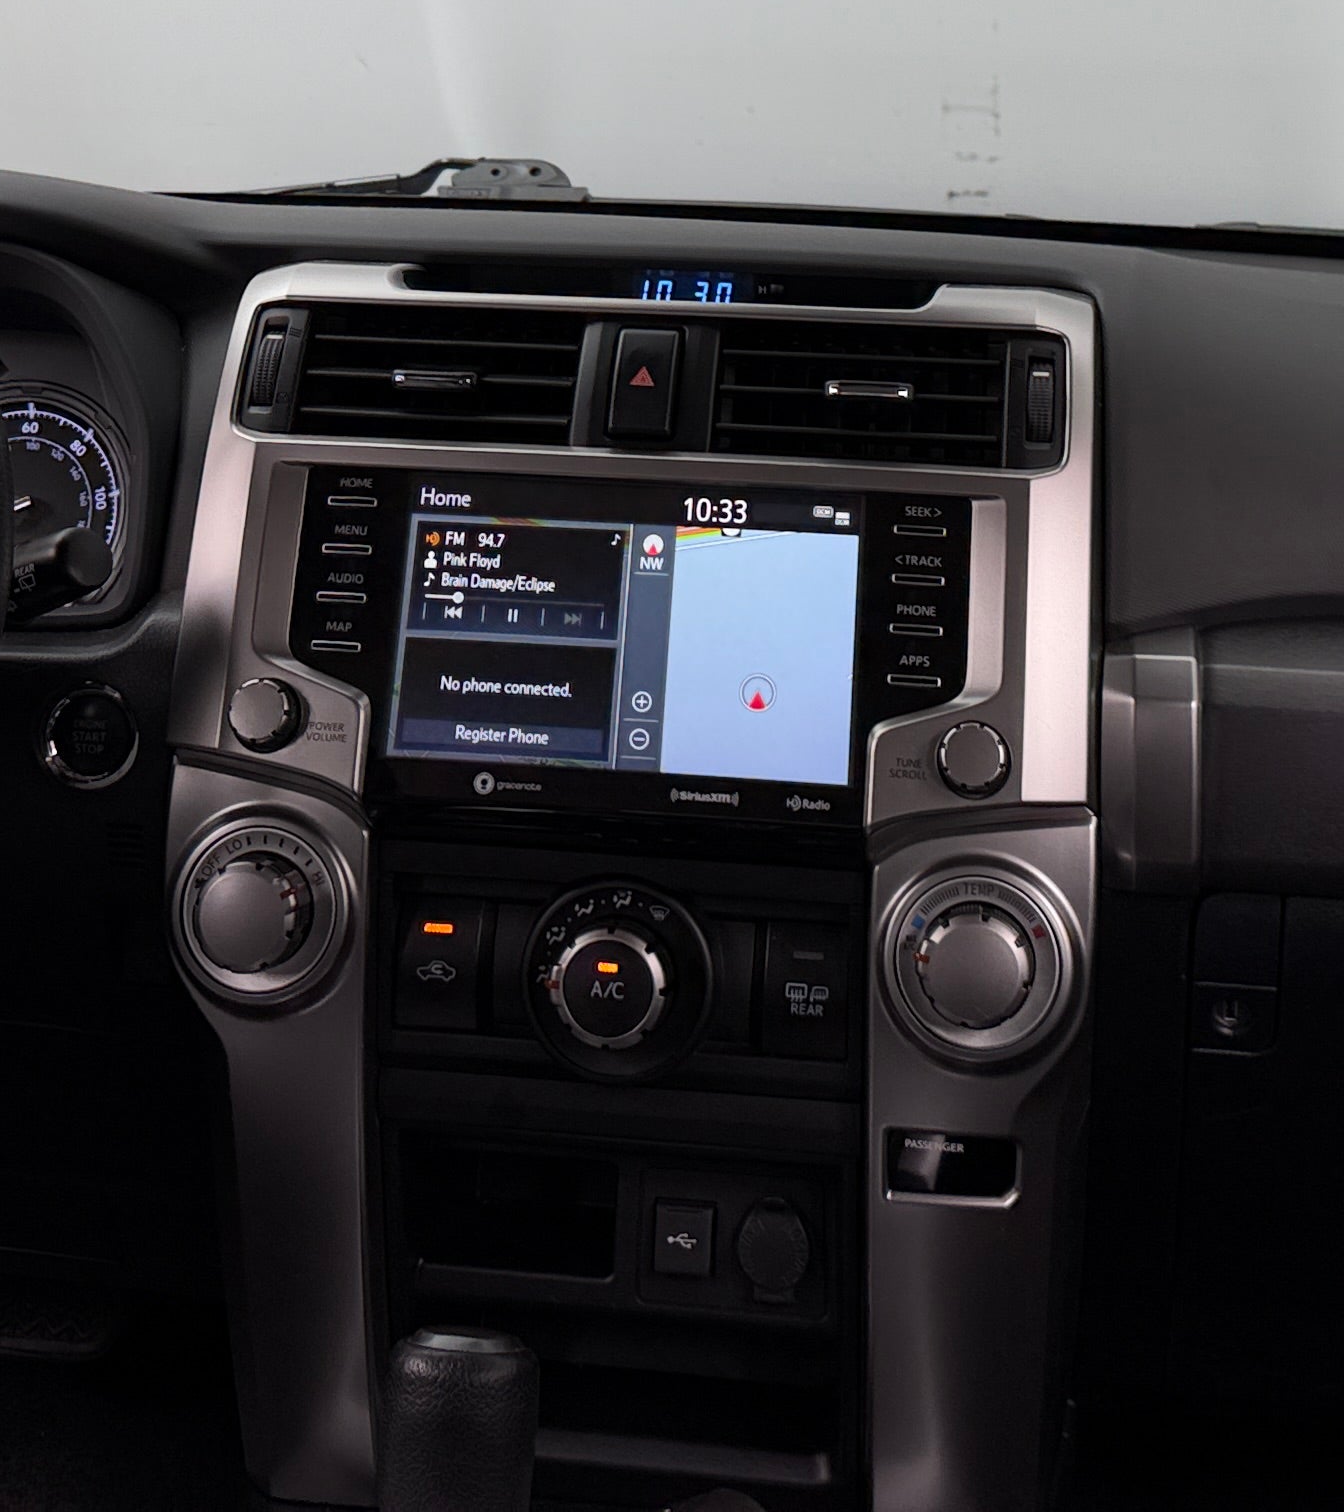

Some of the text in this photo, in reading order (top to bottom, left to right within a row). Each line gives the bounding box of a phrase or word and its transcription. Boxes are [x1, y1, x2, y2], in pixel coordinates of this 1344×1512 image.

[21, 421, 40, 434] 60
[69, 439, 87, 457] 80
[339, 477, 374, 488] HOME
[94, 485, 107, 511] 100
[419, 487, 472, 508] Home
[683, 497, 748, 524] 10:33
[334, 525, 368, 536] MENU
[445, 531, 465, 547] FM
[477, 533, 506, 549] 94.7
[443, 551, 501, 569] Pink Floyd
[639, 557, 664, 570] NW
[14, 563, 35, 578] REAR
[327, 572, 365, 584] AUDIO
[441, 572, 556, 594] Brain Damage/Eclipse
[896, 604, 937, 617] PHONE
[326, 621, 353, 632] MAP
[899, 655, 930, 667] APPS
[440, 675, 572, 698] No phone connected.
[308, 722, 345, 733] POWER
[455, 725, 549, 745] Register Phone
[72, 731, 107, 742] START
[306, 732, 347, 743] VOLUME
[76, 743, 104, 755] STOP
[888, 768, 928, 781] SCROLL
[802, 798, 831, 811] Radio
[225, 839, 243, 855] LO
[201, 853, 226, 877] OFF
[962, 881, 994, 897] TEMP
[590, 980, 625, 1000] A/C
[790, 1002, 824, 1017] REAR
[904, 1138, 965, 1153] PASSENGER
